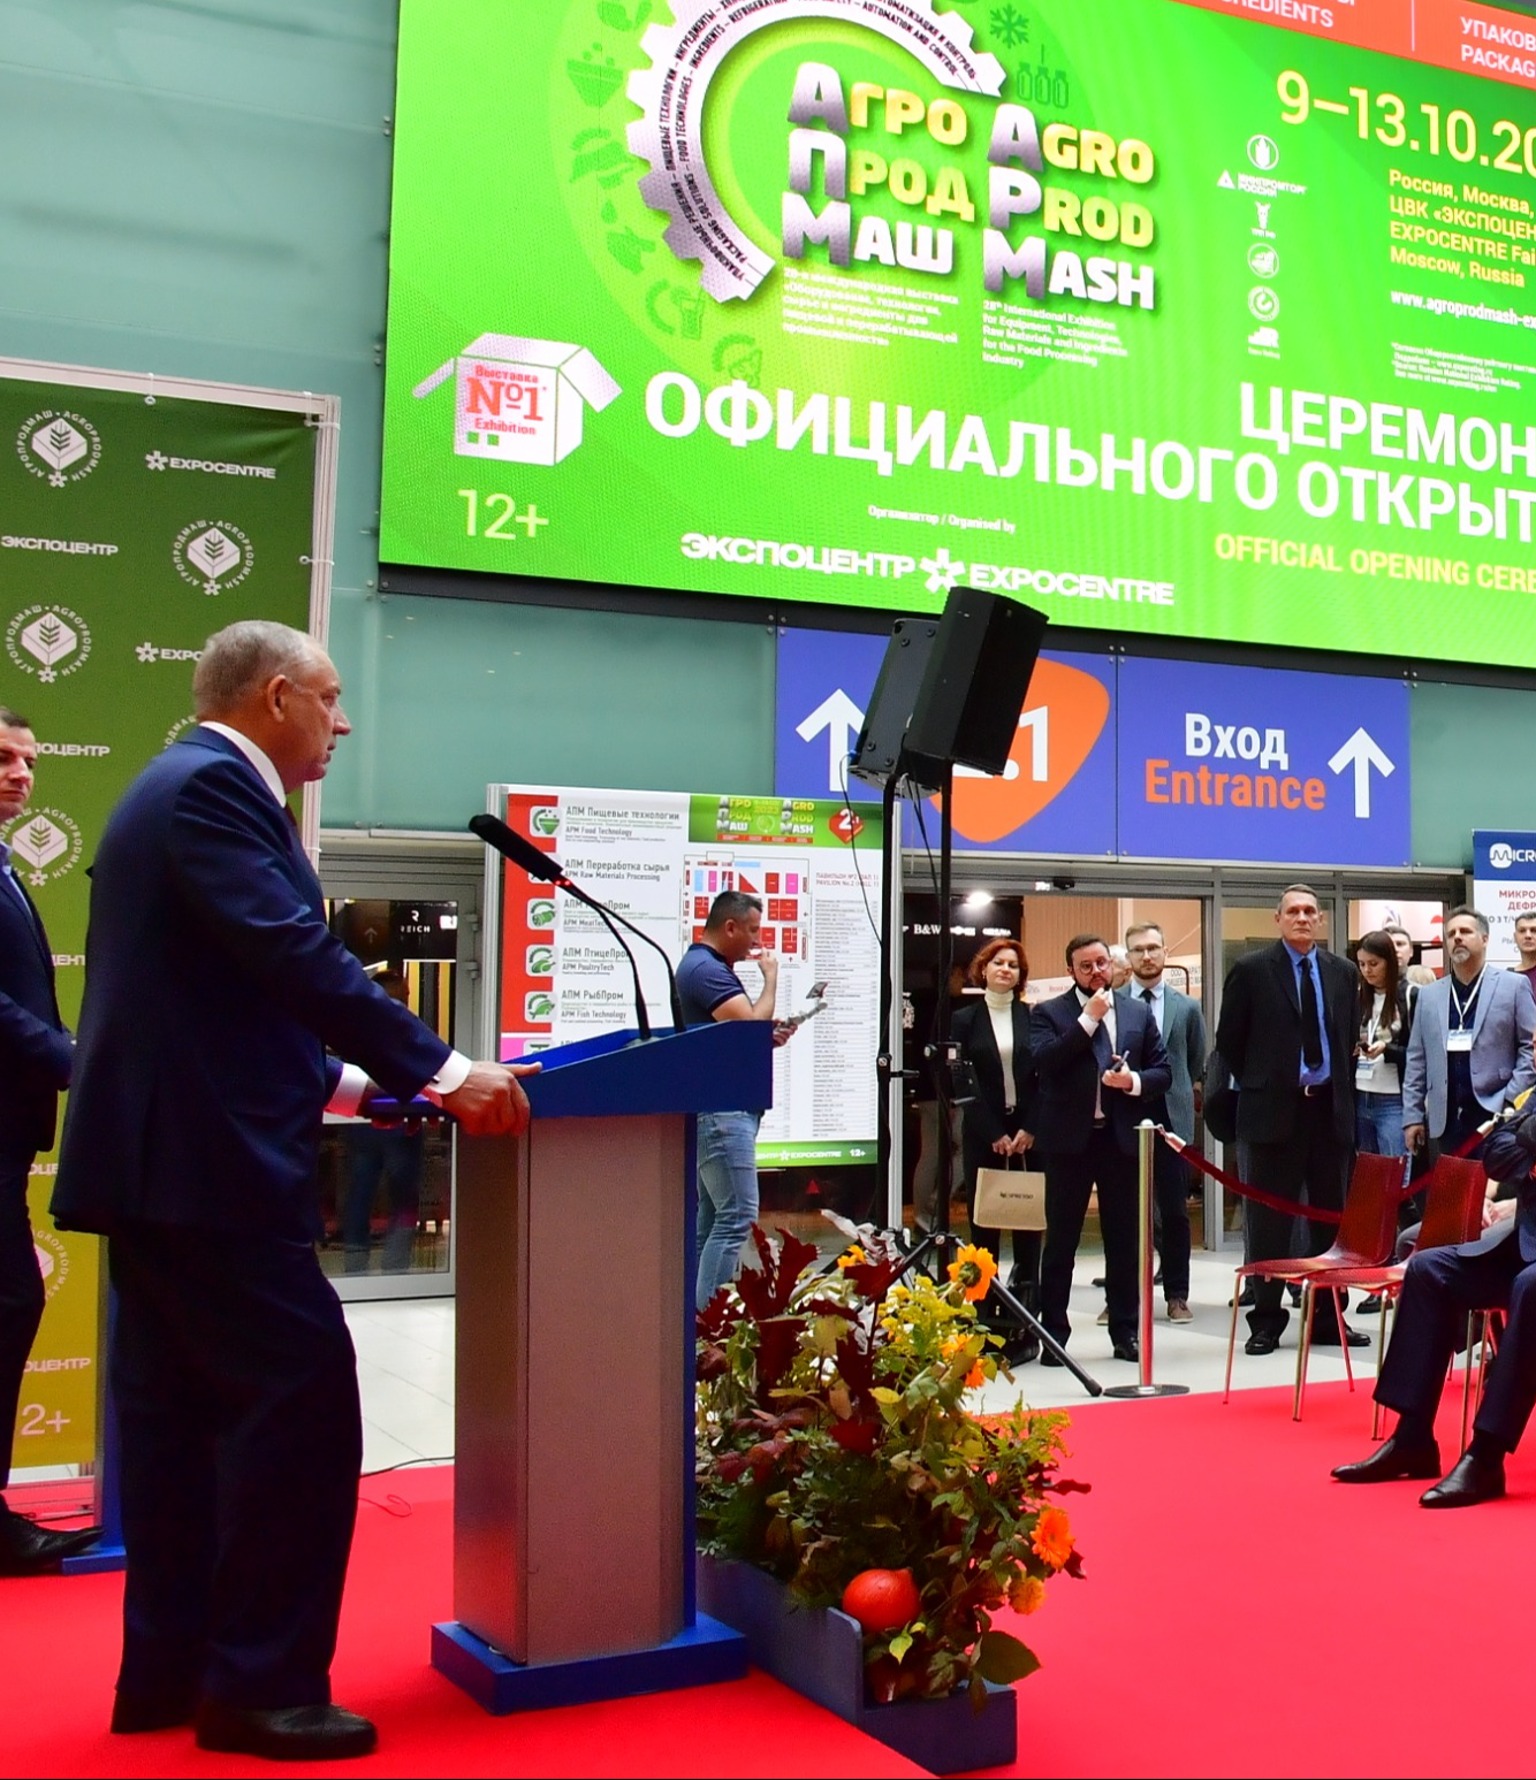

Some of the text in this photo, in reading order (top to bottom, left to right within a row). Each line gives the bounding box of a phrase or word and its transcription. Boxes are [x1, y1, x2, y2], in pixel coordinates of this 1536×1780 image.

[787, 61, 967, 146] АГРО
[675, 138, 690, 162] FOOD
[988, 103, 1154, 184] AGRO
[788, 128, 975, 222] ПРОД
[989, 165, 1154, 248] PROD
[1389, 169, 1535, 218] Россия, Москва,
[1390, 195, 1429, 218] ЦВК
[782, 191, 953, 274] МАШ
[1390, 221, 1507, 261] EXPOCENTRE
[983, 228, 1154, 310] MASH
[1390, 246, 1526, 288] Moscow, Russia
[474, 364, 539, 383] Выставка
[474, 418, 536, 435] Exhibition
[645, 371, 1279, 510] ОФИЦИАЛЬНОГО
[169, 456, 276, 479] EXPOCENTRE
[457, 489, 549, 540] 12+
[1, 535, 119, 556] ЭКСПОЦЕНТР
[1214, 533, 1342, 573] OFFICIAL
[1350, 549, 1469, 586] OPENING
[681, 532, 1175, 606] ЭКСПОЦЕНТР EXPOCENTRE
[1185, 712, 1289, 770] Вход
[1145, 759, 1326, 811] Entrance
[566, 806, 680, 820] АПМ Пищевые технологии
[598, 828, 632, 837] Technology
[565, 859, 670, 873] АПМ Переработка сырья
[595, 872, 625, 880] Materials
[627, 872, 660, 881] Processing
[914, 924, 941, 935] B&W
[563, 948, 581, 957] АПМ
[578, 963, 614, 972] PoultryTech
[562, 990, 623, 1001] АПМ РыбПром
[577, 1010, 590, 1018] Fish
[592, 1011, 626, 1019] Technology
[21, 1403, 70, 1436] 2+
